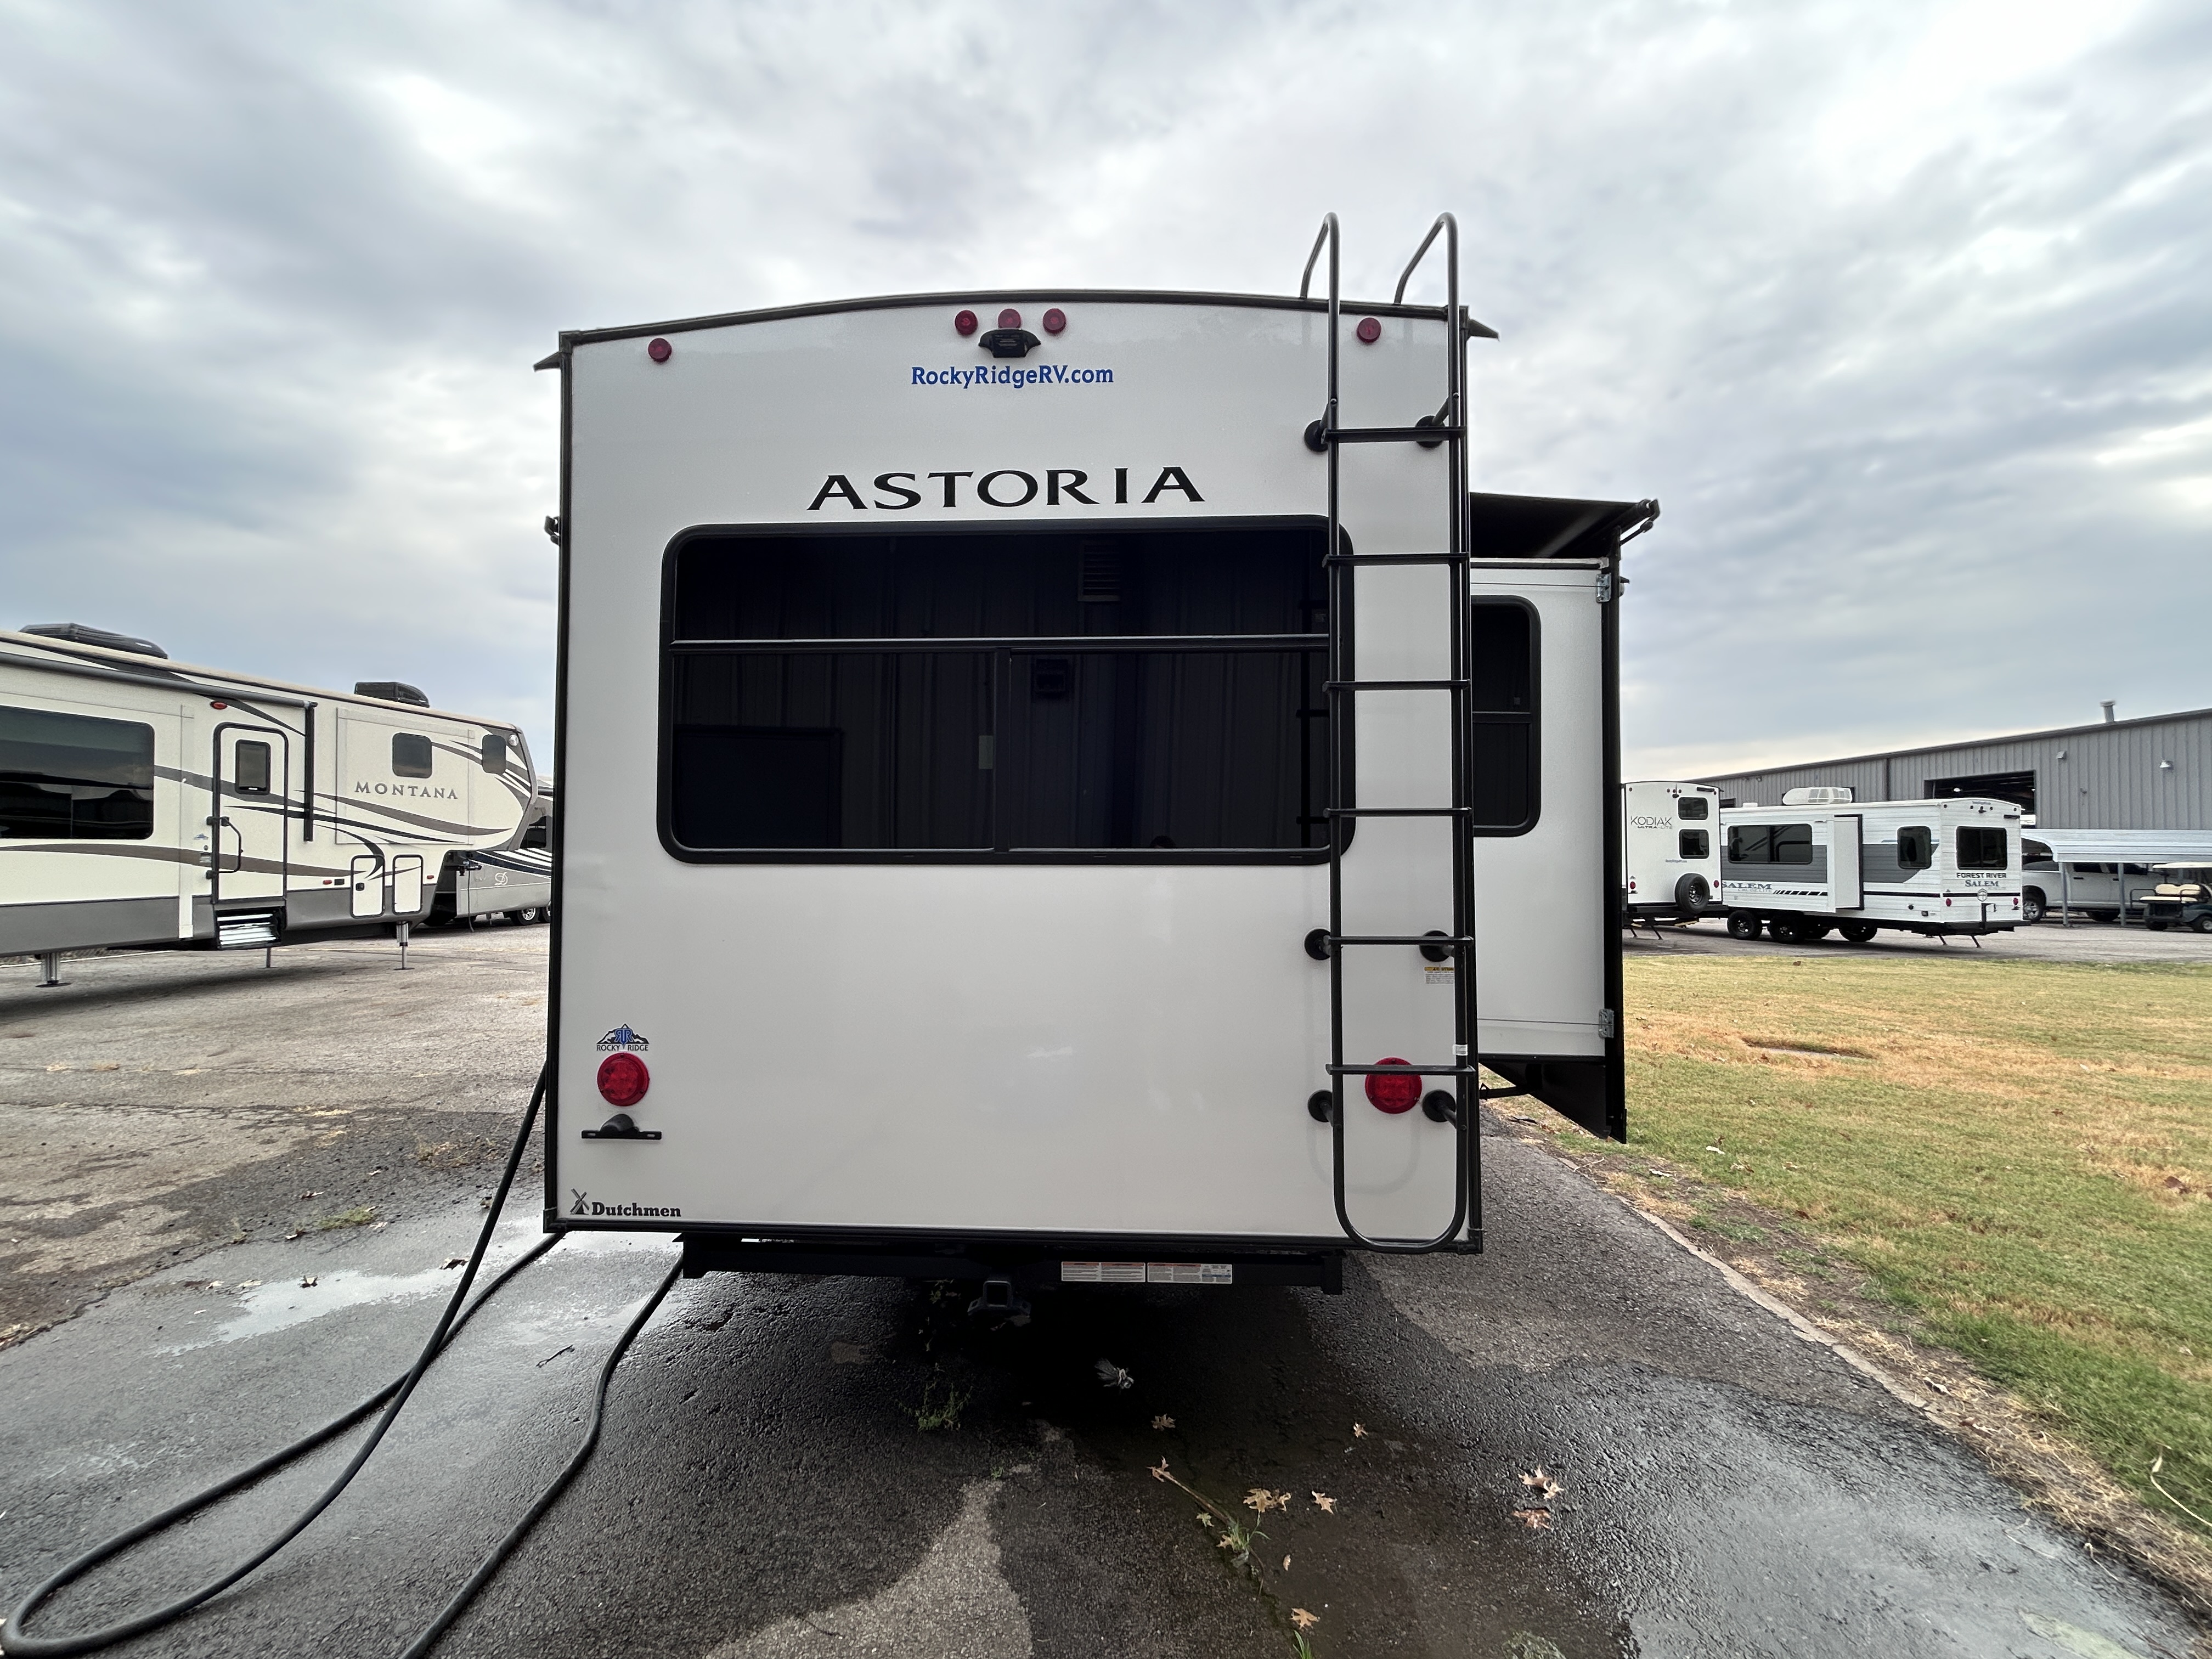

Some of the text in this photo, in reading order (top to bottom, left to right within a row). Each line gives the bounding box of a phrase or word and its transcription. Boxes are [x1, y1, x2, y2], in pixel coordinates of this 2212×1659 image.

[911, 365, 1114, 389] RockyRidgeRV.com
[806, 466, 1205, 511] ASTORIA
[354, 781, 458, 799] MONTANA
[1630, 816, 1672, 826] KODIAK
[1722, 881, 1773, 889] SALEM
[591, 1201, 681, 1217] Dutchmen
